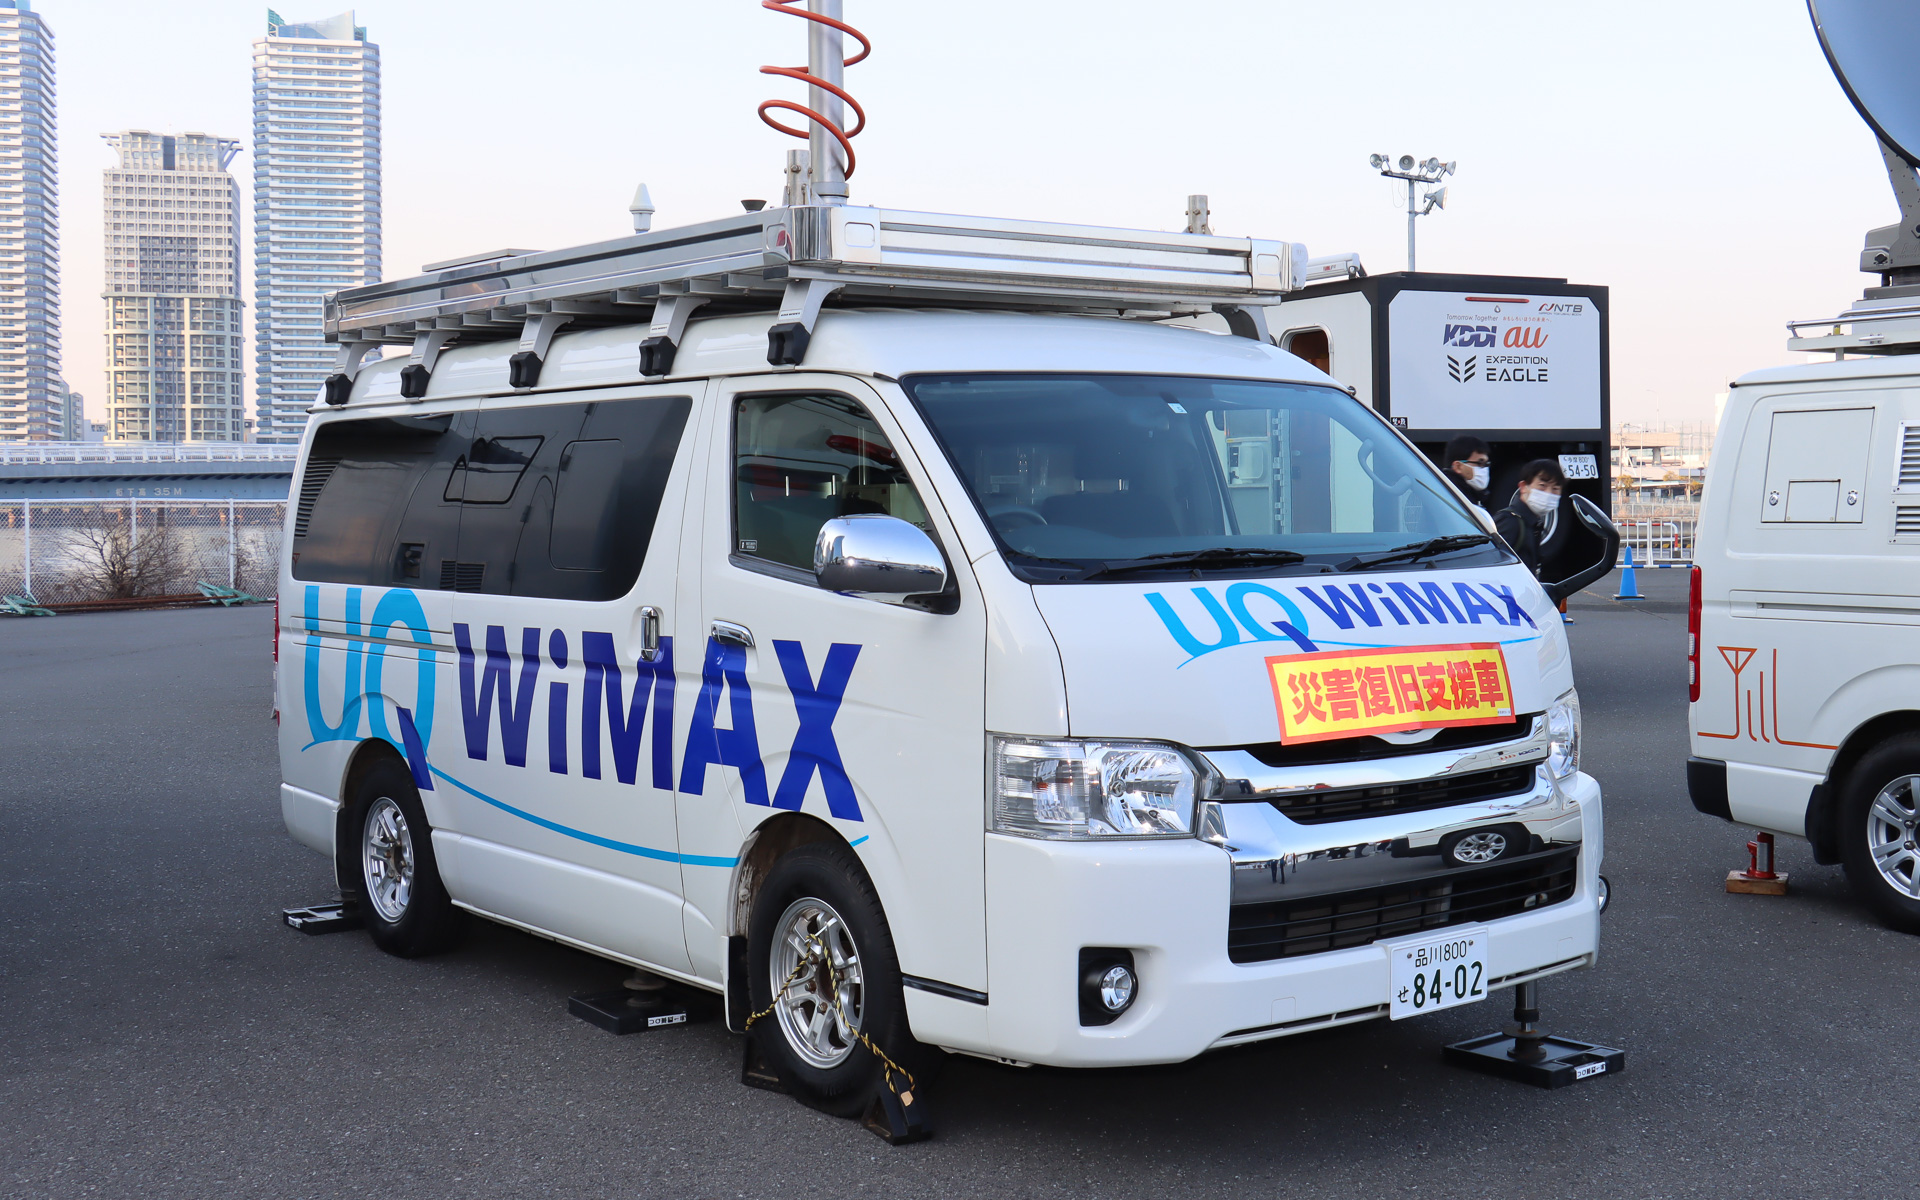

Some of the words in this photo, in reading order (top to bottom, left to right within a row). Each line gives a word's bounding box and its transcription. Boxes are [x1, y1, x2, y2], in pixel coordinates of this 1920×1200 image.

[1554, 303, 1583, 313] NTB
[1474, 314, 1498, 322] Together
[1443, 324, 1497, 347] KDDI
[1503, 326, 1549, 348] au
[1486, 355, 1549, 365] EXPEDITION
[1486, 368, 1549, 382] EAGLE
[1568, 464, 1596, 477] 54-50
[173, 487, 182, 496] M
[1144, 582, 1319, 660] UQ
[1296, 581, 1540, 631] WiMAX
[1287, 659, 1505, 725] 災害復旧支援車
[302, 585, 435, 791] UQ
[453, 622, 864, 822] WiMAX
[1413, 960, 1483, 1009] 84-02
